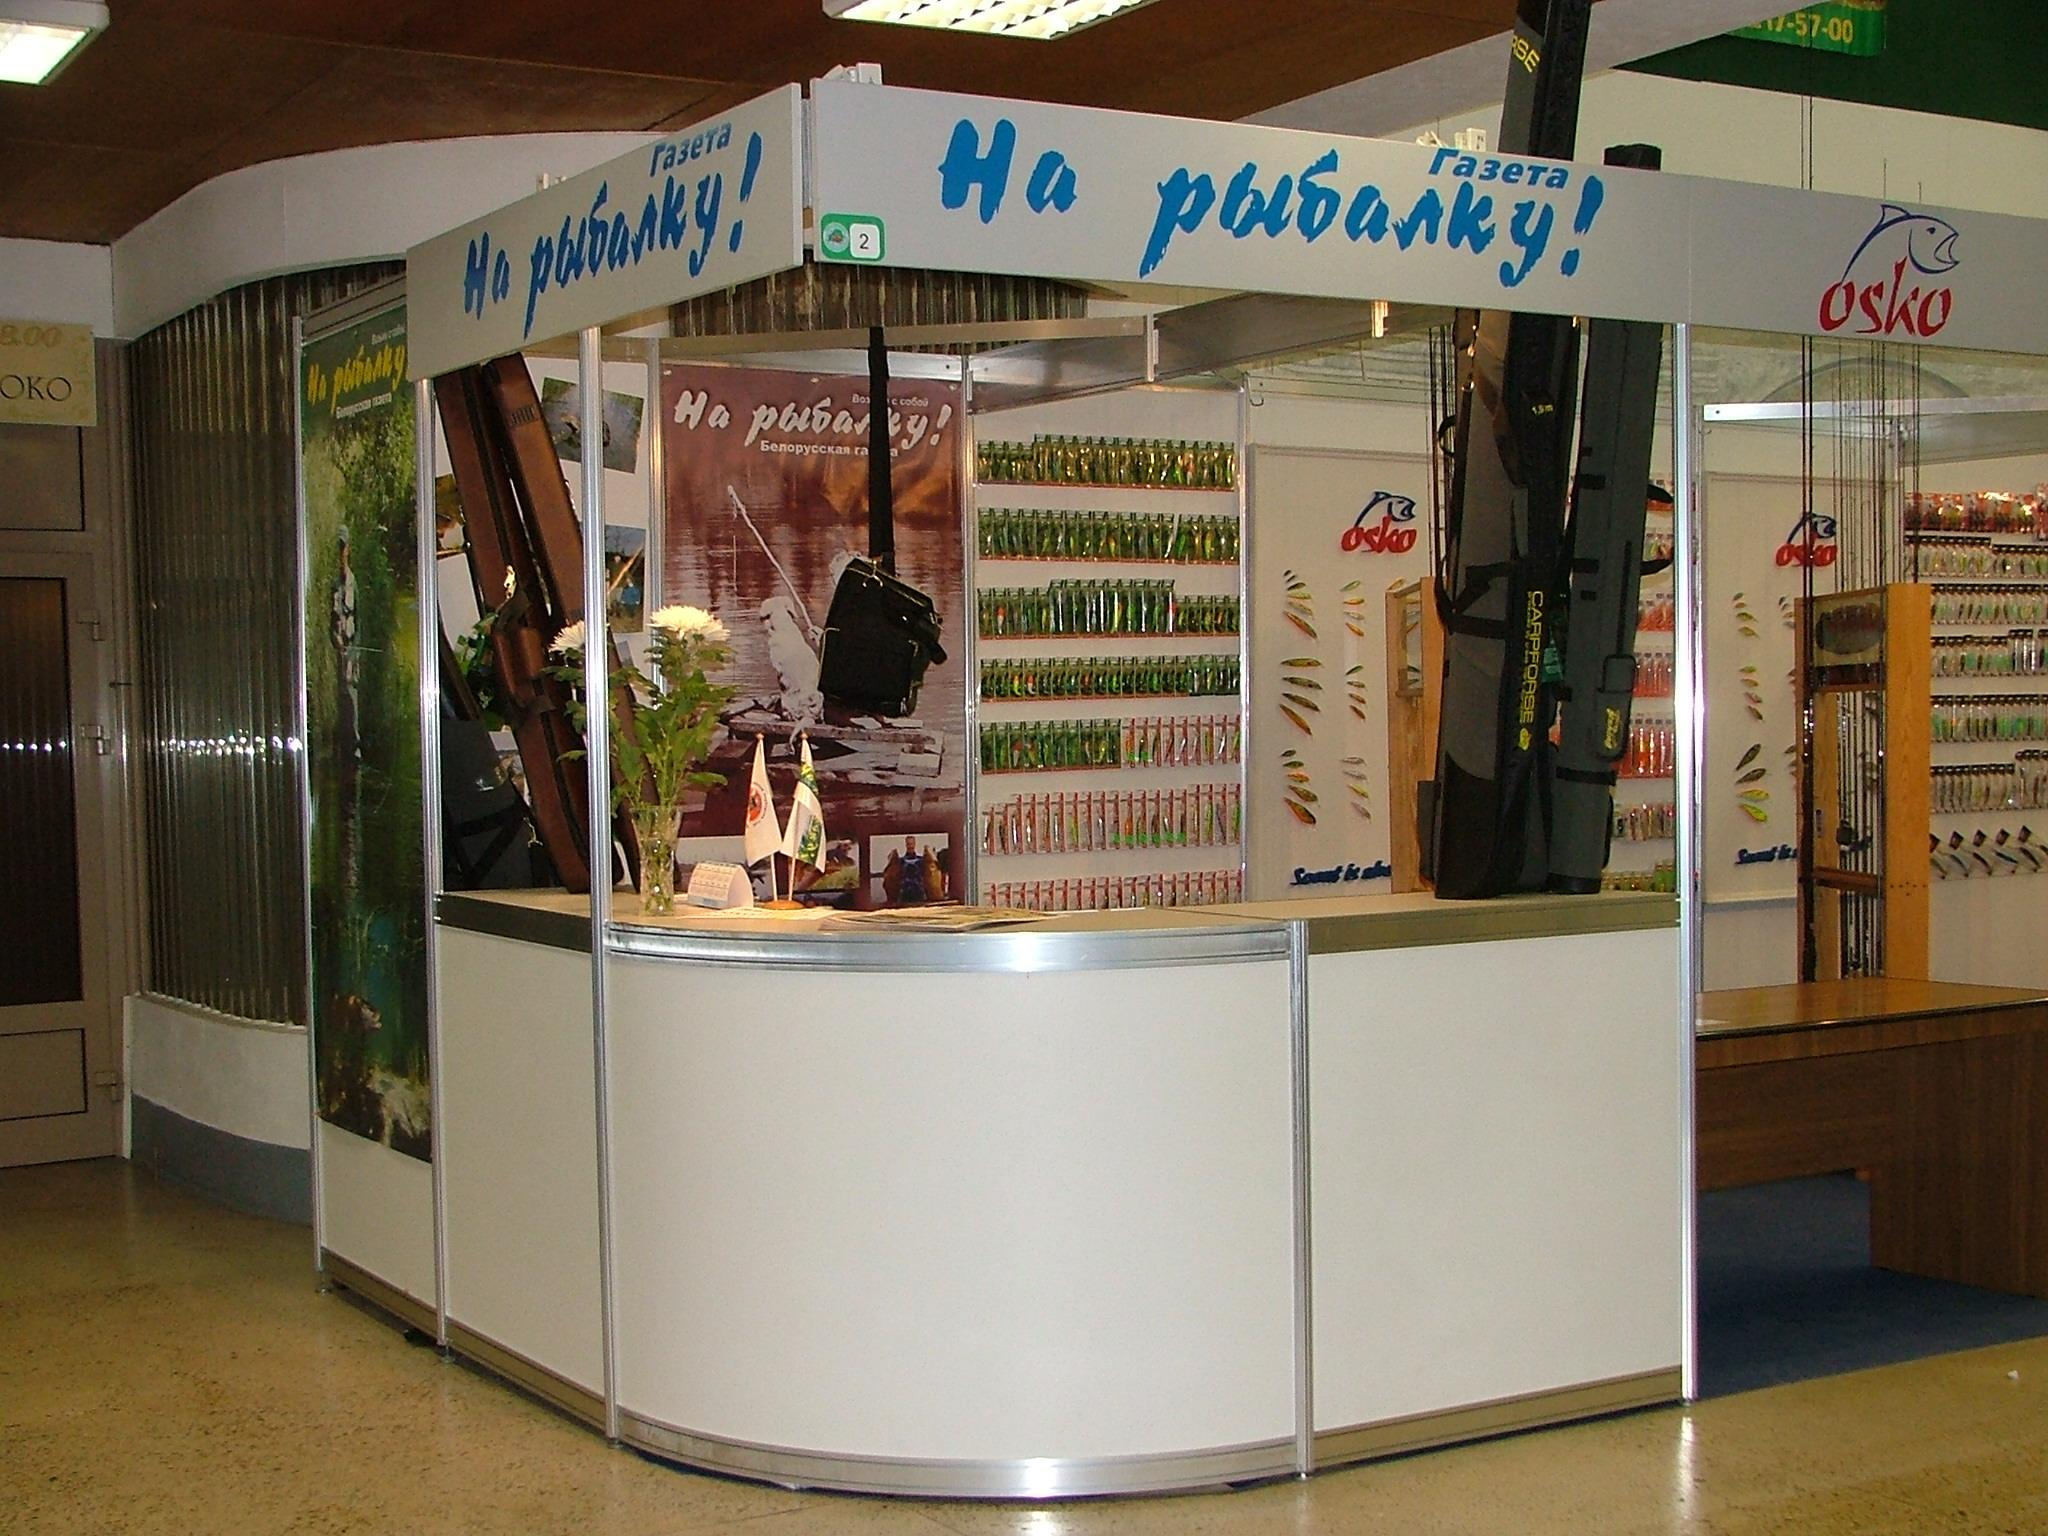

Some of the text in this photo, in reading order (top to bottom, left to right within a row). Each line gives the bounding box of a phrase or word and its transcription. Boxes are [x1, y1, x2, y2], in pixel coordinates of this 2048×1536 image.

[1752, 13, 1854, 44] 17-57-00
[650, 122, 732, 177] Газета
[1428, 147, 1570, 190] Газета
[938, 118, 1078, 225] На
[858, 232, 870, 250] 2
[464, 231, 510, 320] На
[1818, 256, 1953, 338] osko
[674, 390, 731, 430] На
[852, 393, 891, 406] Воз
[760, 440, 898, 458] Белорусская гаа
[1520, 590, 1544, 723] CARPFORSE
